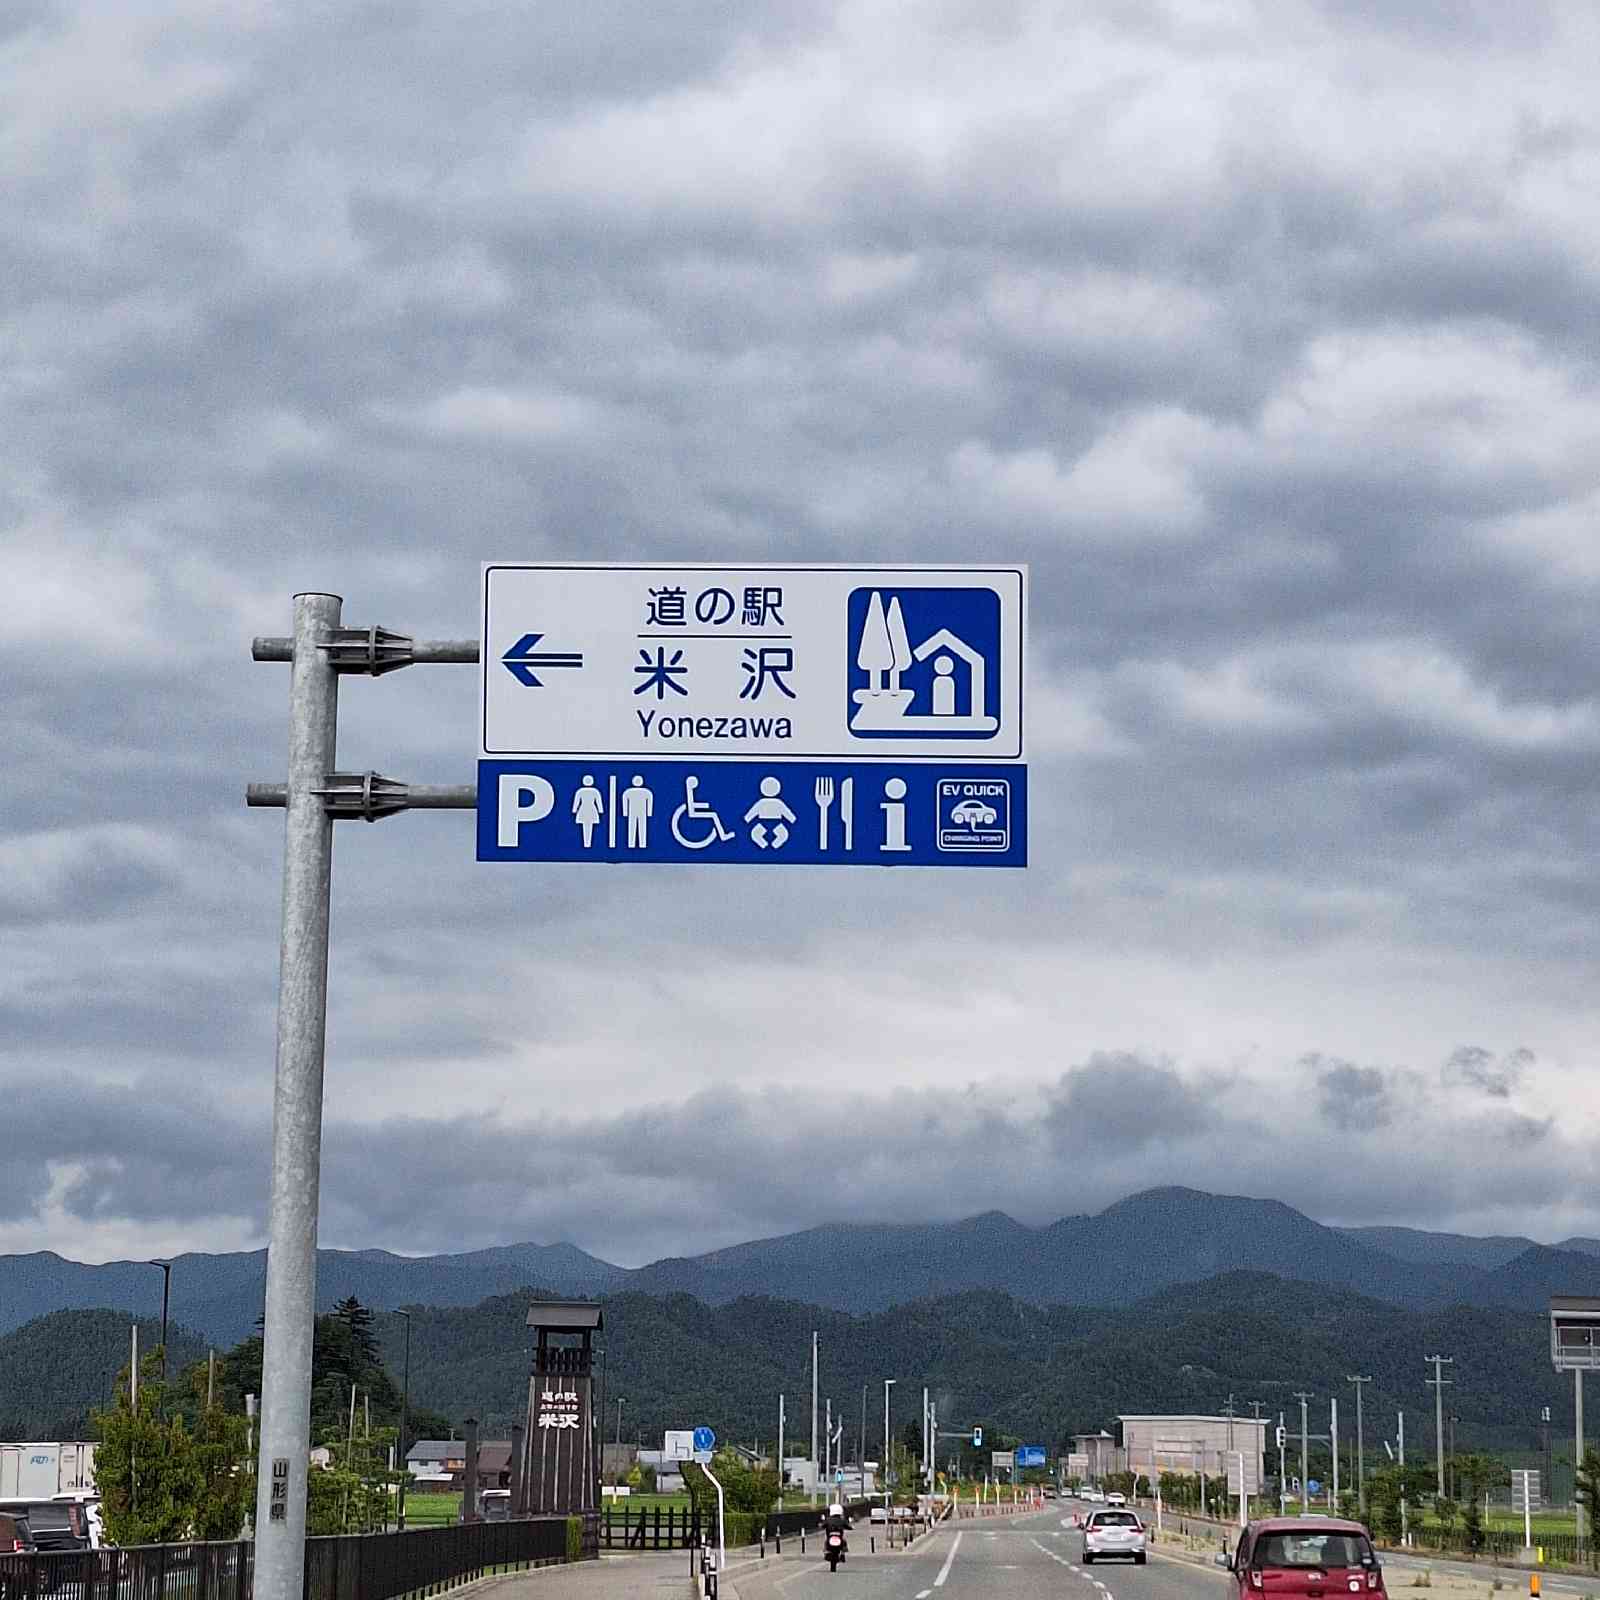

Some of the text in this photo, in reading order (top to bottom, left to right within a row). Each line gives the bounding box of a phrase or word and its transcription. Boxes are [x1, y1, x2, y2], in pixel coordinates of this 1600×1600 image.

[646, 586, 785, 626] 道の駅
[633, 646, 797, 700] 米沢
[636, 709, 793, 739] Yonezawa
[498, 774, 555, 847] P
[942, 784, 1005, 797] EV QUICK
